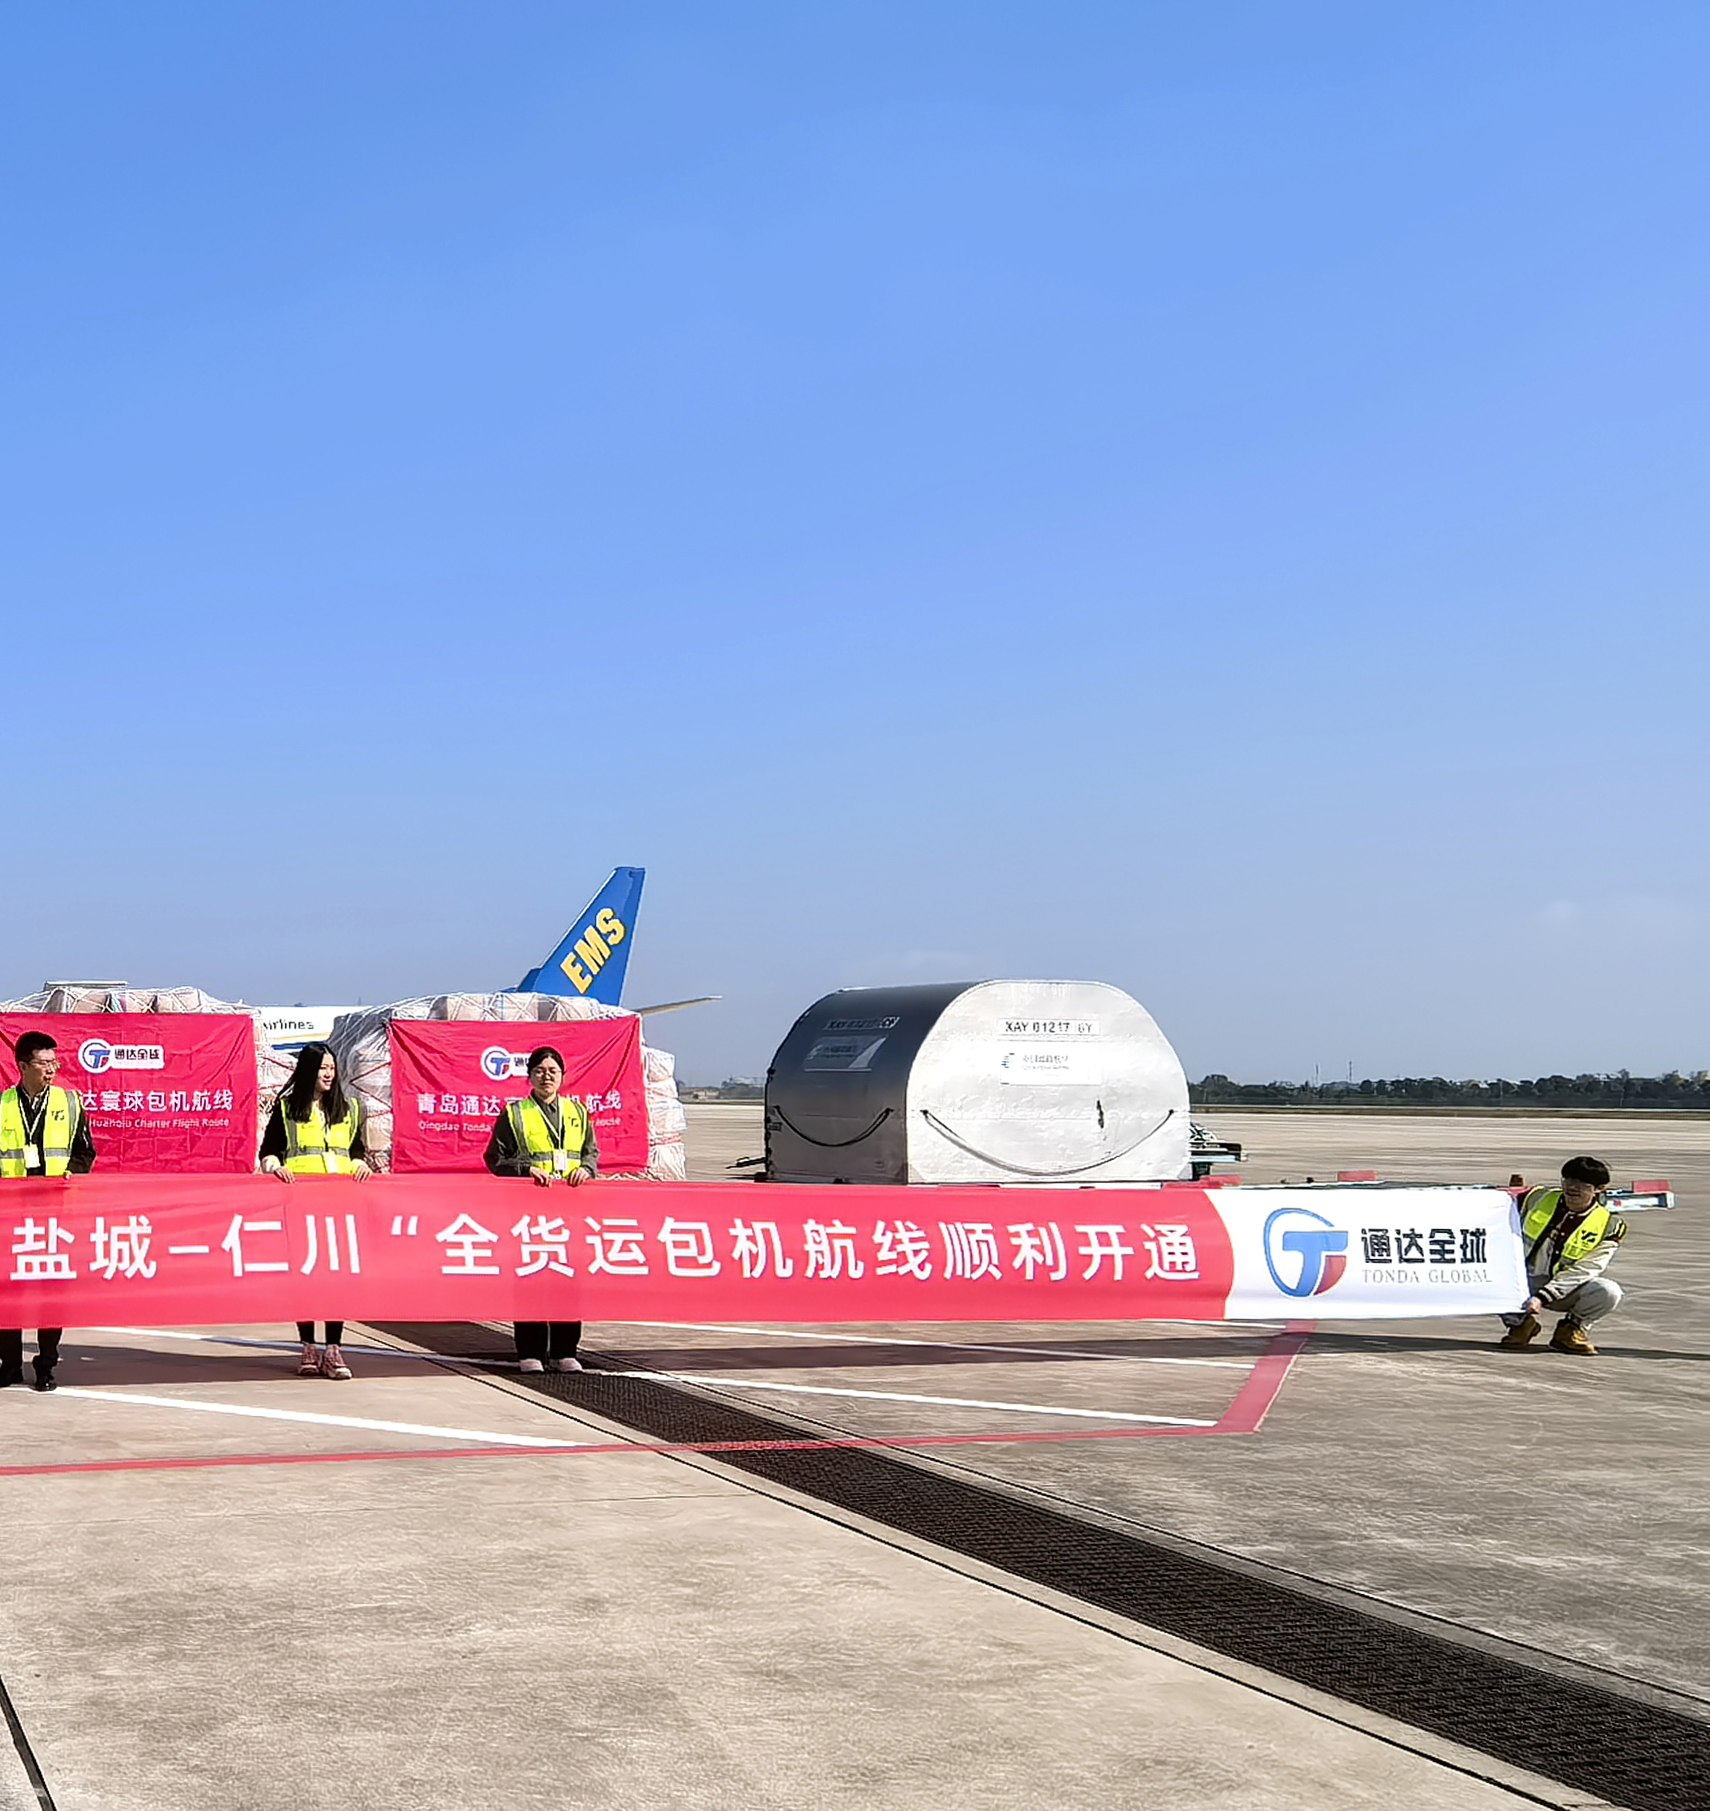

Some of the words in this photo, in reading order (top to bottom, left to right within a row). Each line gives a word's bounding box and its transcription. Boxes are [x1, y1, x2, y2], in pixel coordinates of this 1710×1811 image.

[559, 907, 625, 995] EMS
[134, 1118, 170, 1128] Charter
[1361, 1227, 1488, 1264] 通达全球
[1361, 1268, 1420, 1284] TONDA
[1428, 1268, 1494, 1283] GLOBAL
